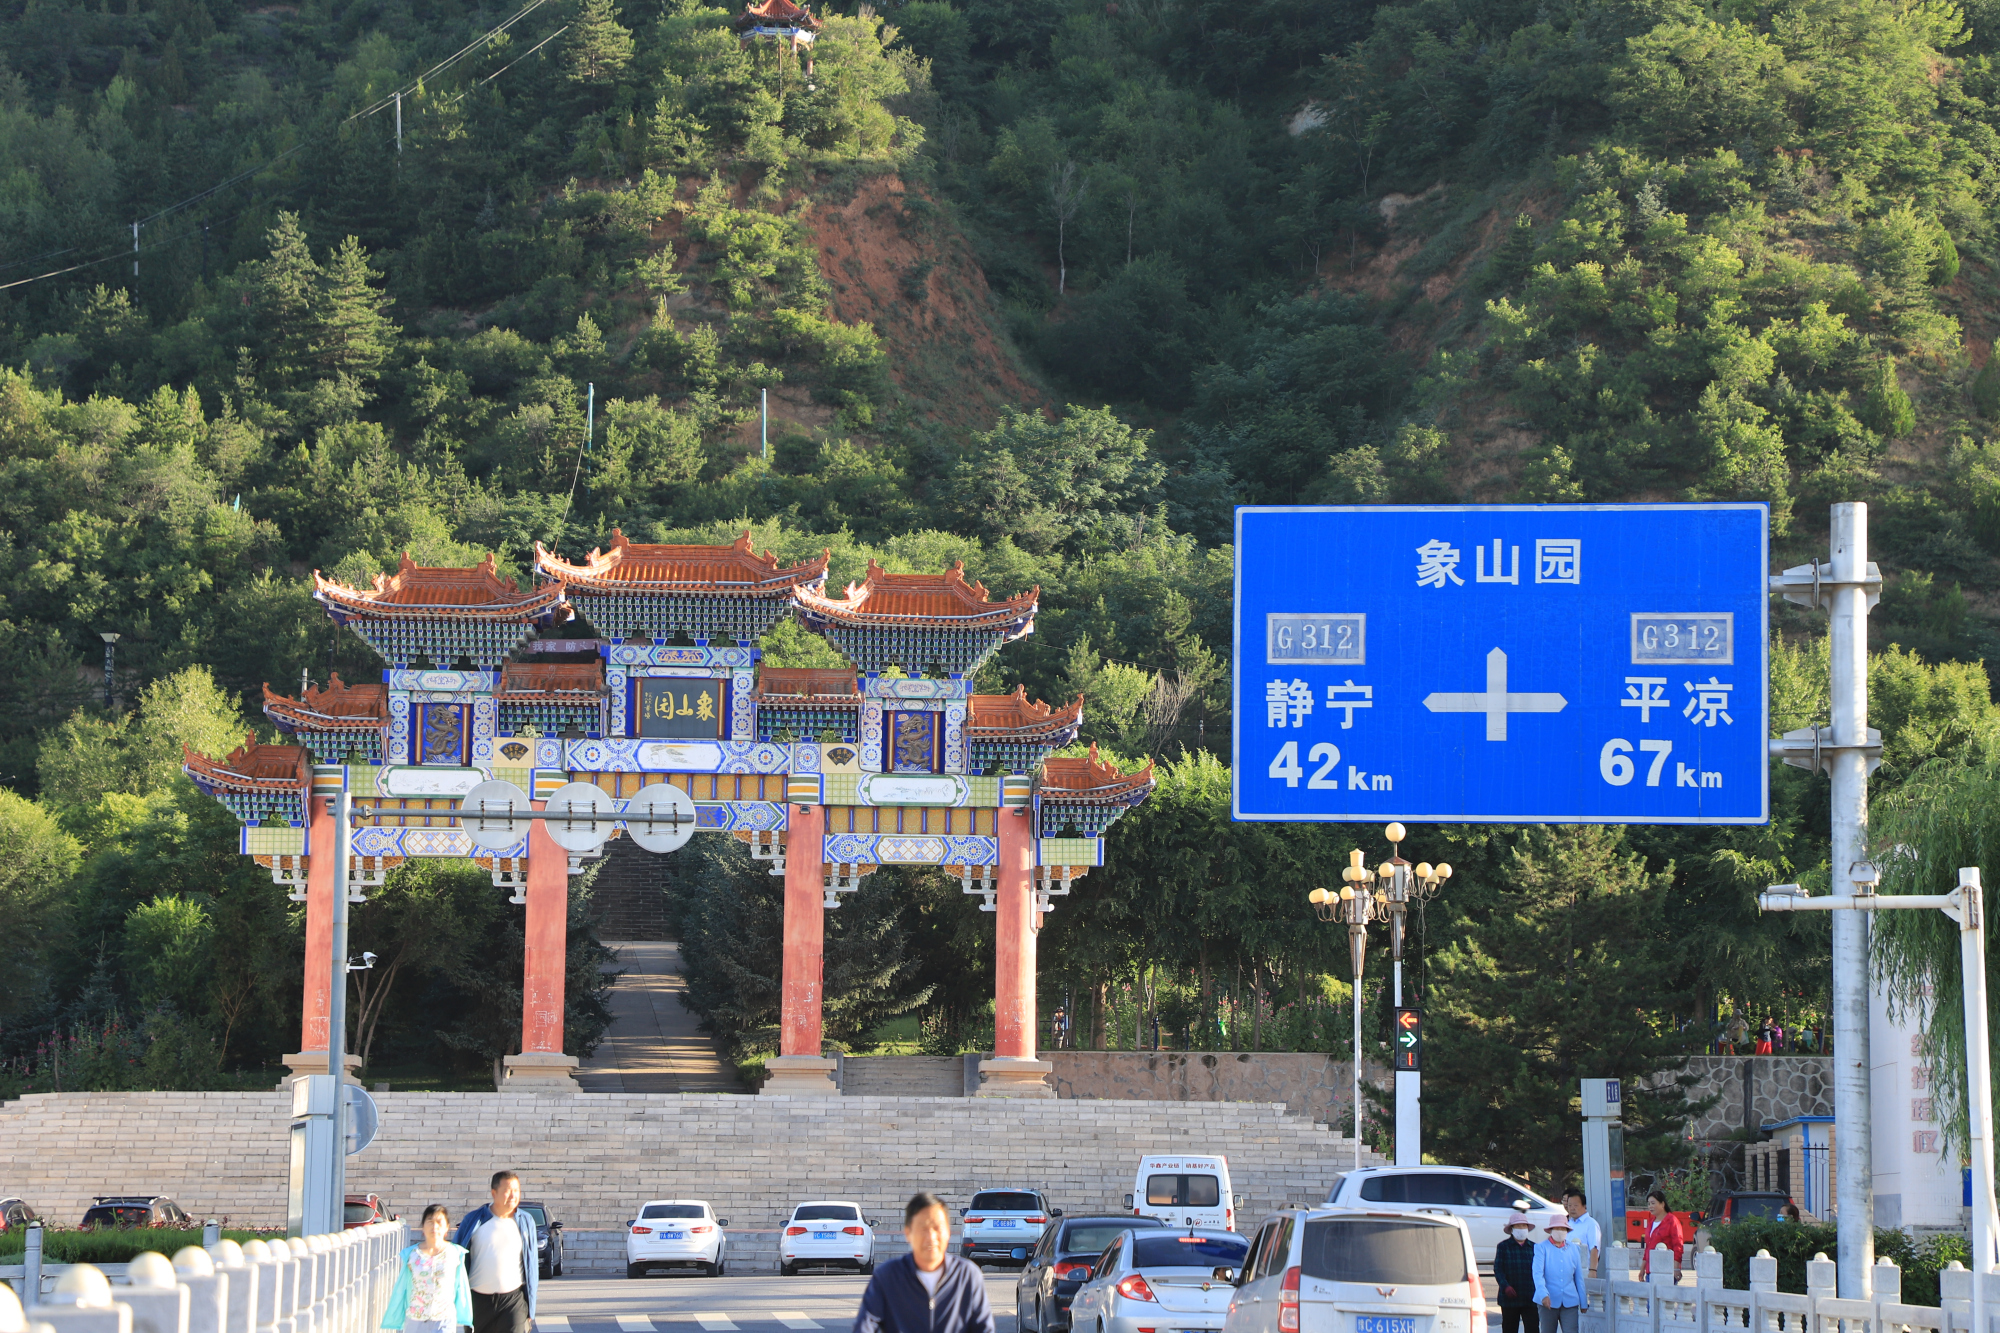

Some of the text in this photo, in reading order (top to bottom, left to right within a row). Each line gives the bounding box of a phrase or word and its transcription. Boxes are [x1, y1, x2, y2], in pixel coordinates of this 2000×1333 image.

[1415, 538, 1581, 588] 象山园
[1277, 624, 1353, 649] G312
[1642, 623, 1720, 651] G312
[1265, 678, 1373, 730] 静宁
[1620, 676, 1734, 727] 平凉
